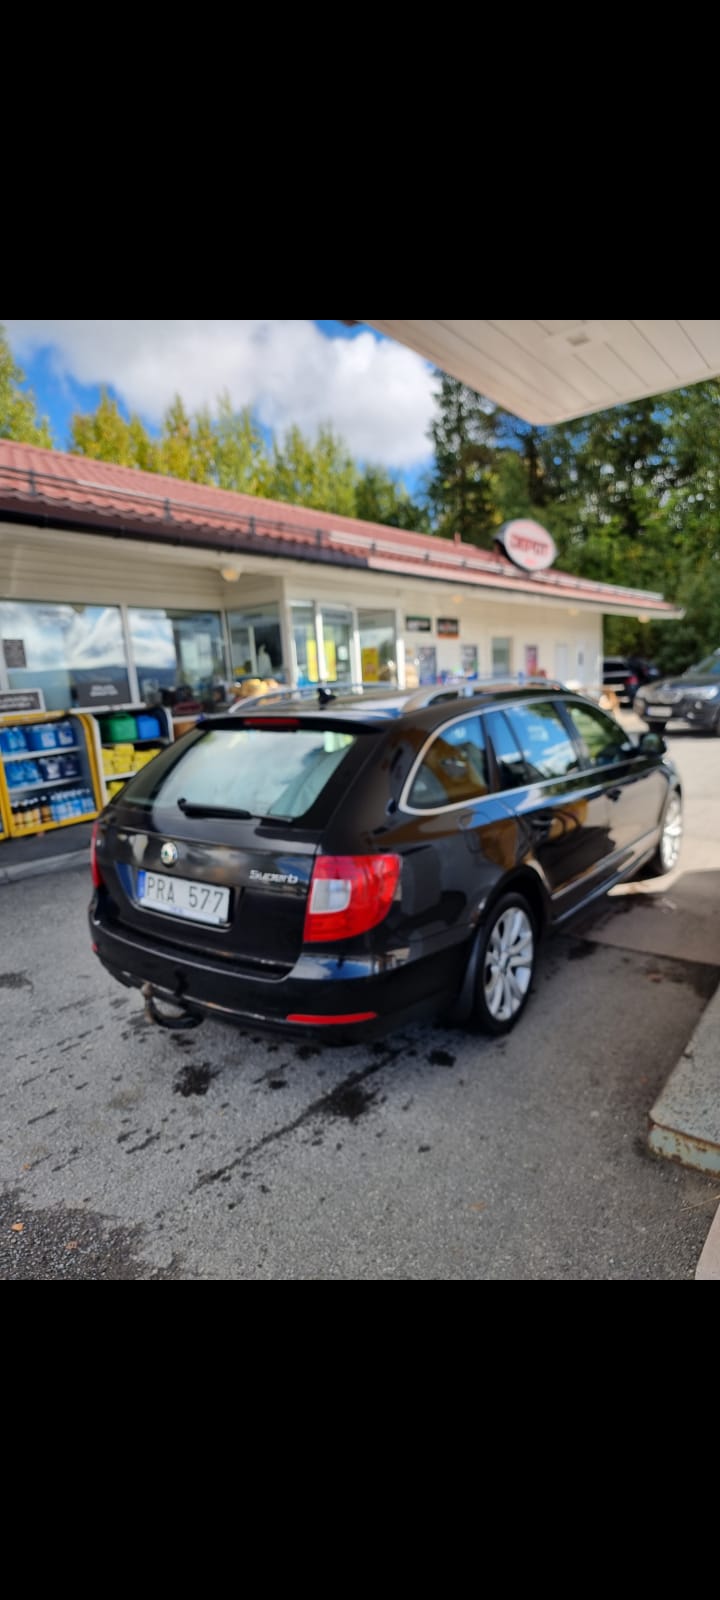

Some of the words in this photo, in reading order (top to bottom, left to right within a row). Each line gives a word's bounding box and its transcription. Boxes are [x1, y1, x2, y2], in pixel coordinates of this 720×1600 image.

[249, 869, 299, 884] Superb
[147, 875, 175, 904] PRA
[188, 885, 224, 913] 577
